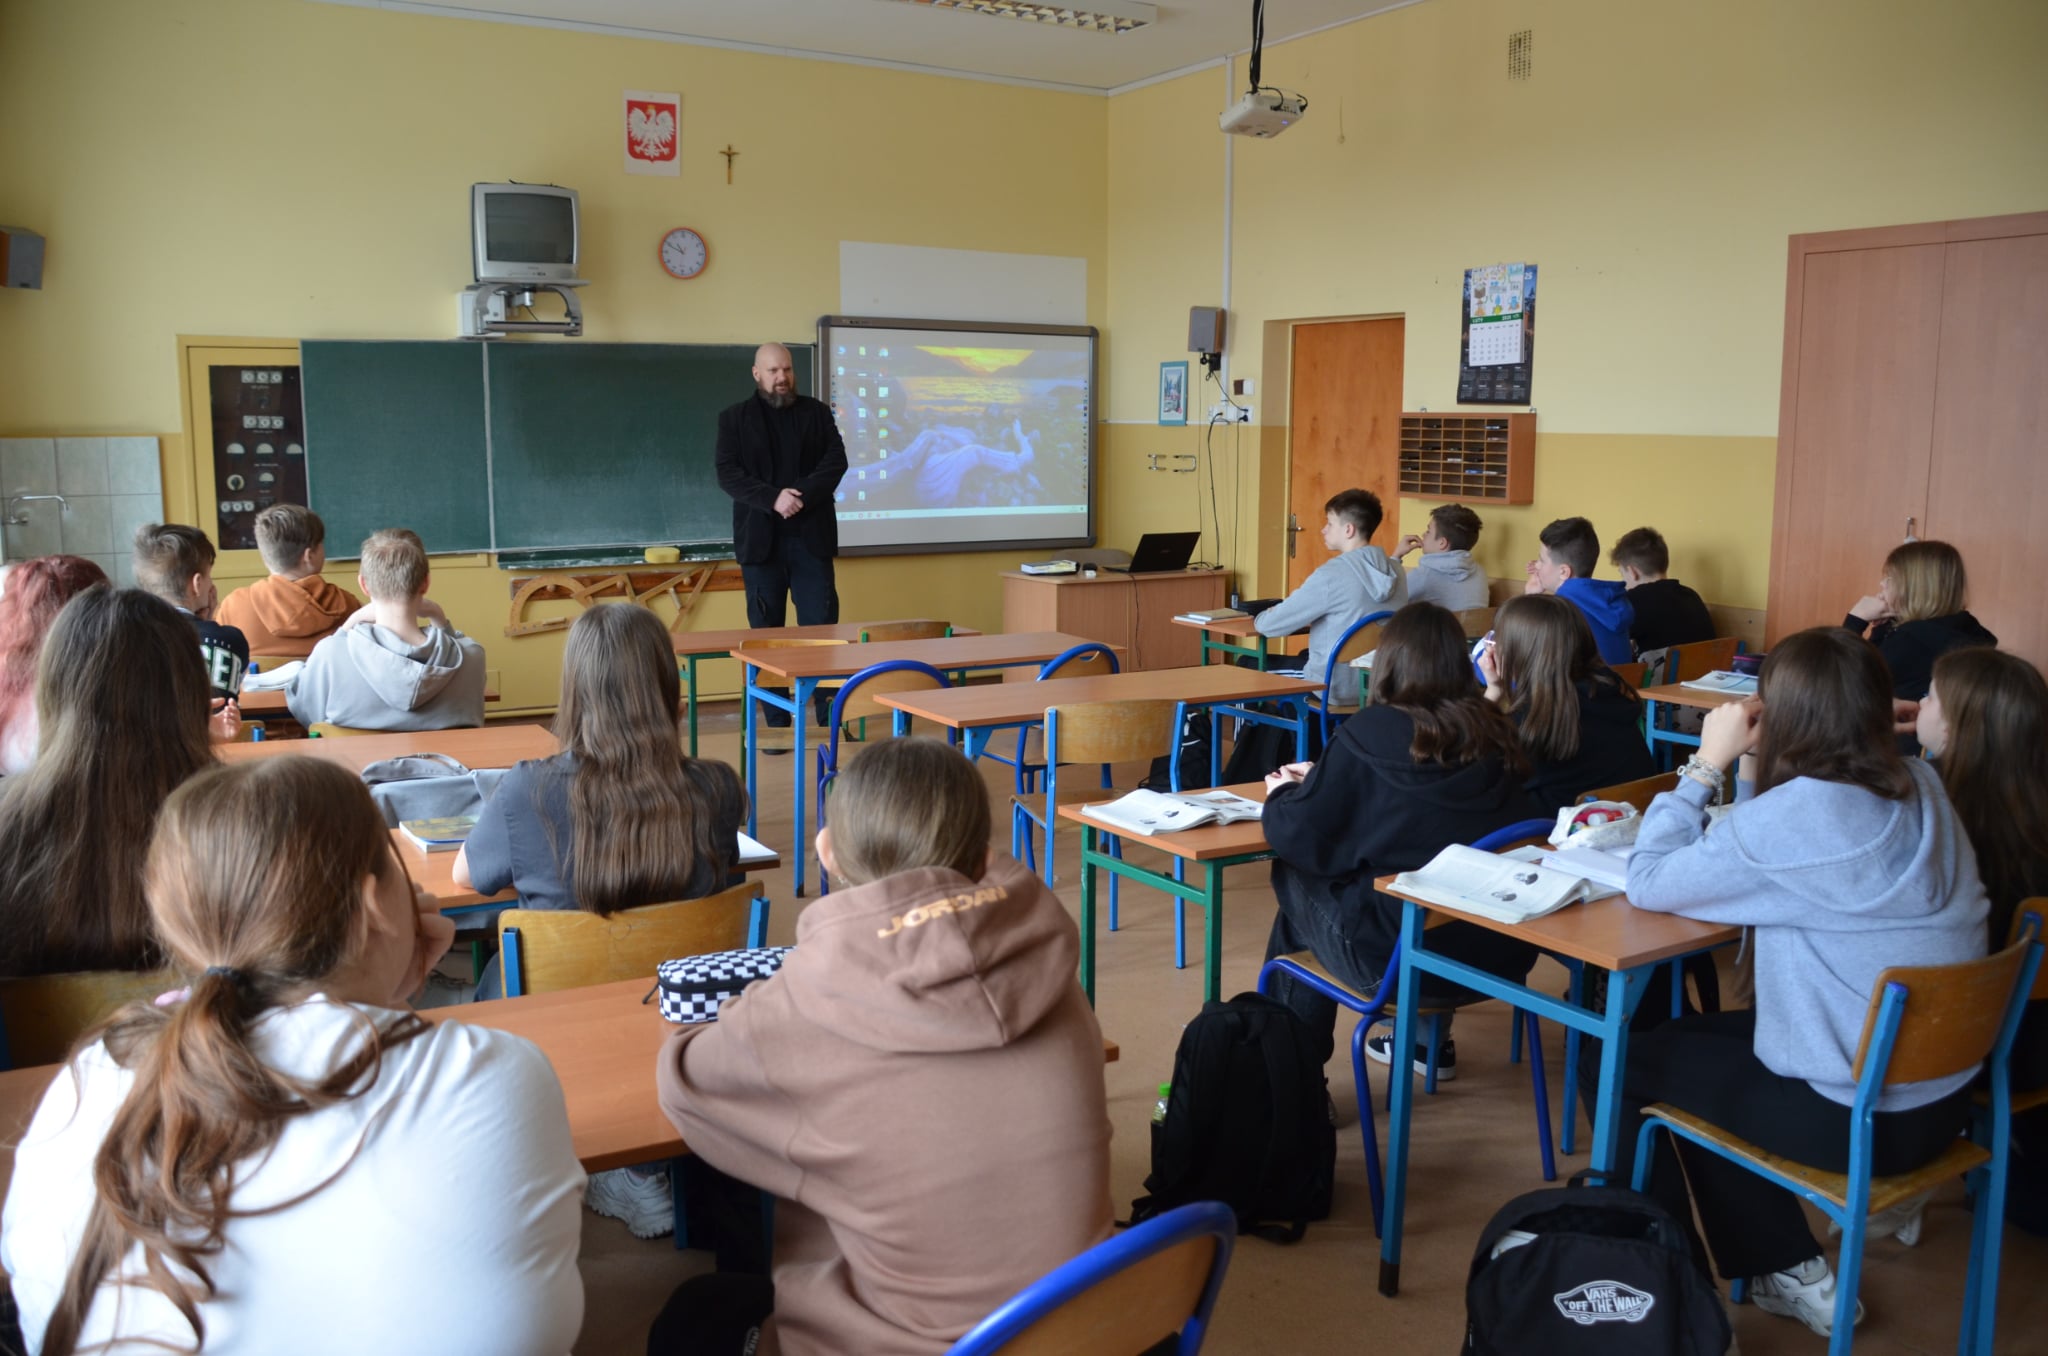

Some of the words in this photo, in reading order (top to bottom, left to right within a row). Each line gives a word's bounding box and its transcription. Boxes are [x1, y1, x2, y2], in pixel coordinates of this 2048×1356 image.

[877, 886, 1008, 939] JORDAN
[1583, 1287, 1617, 1300] VANS
[1589, 1300, 1613, 1312] THE
